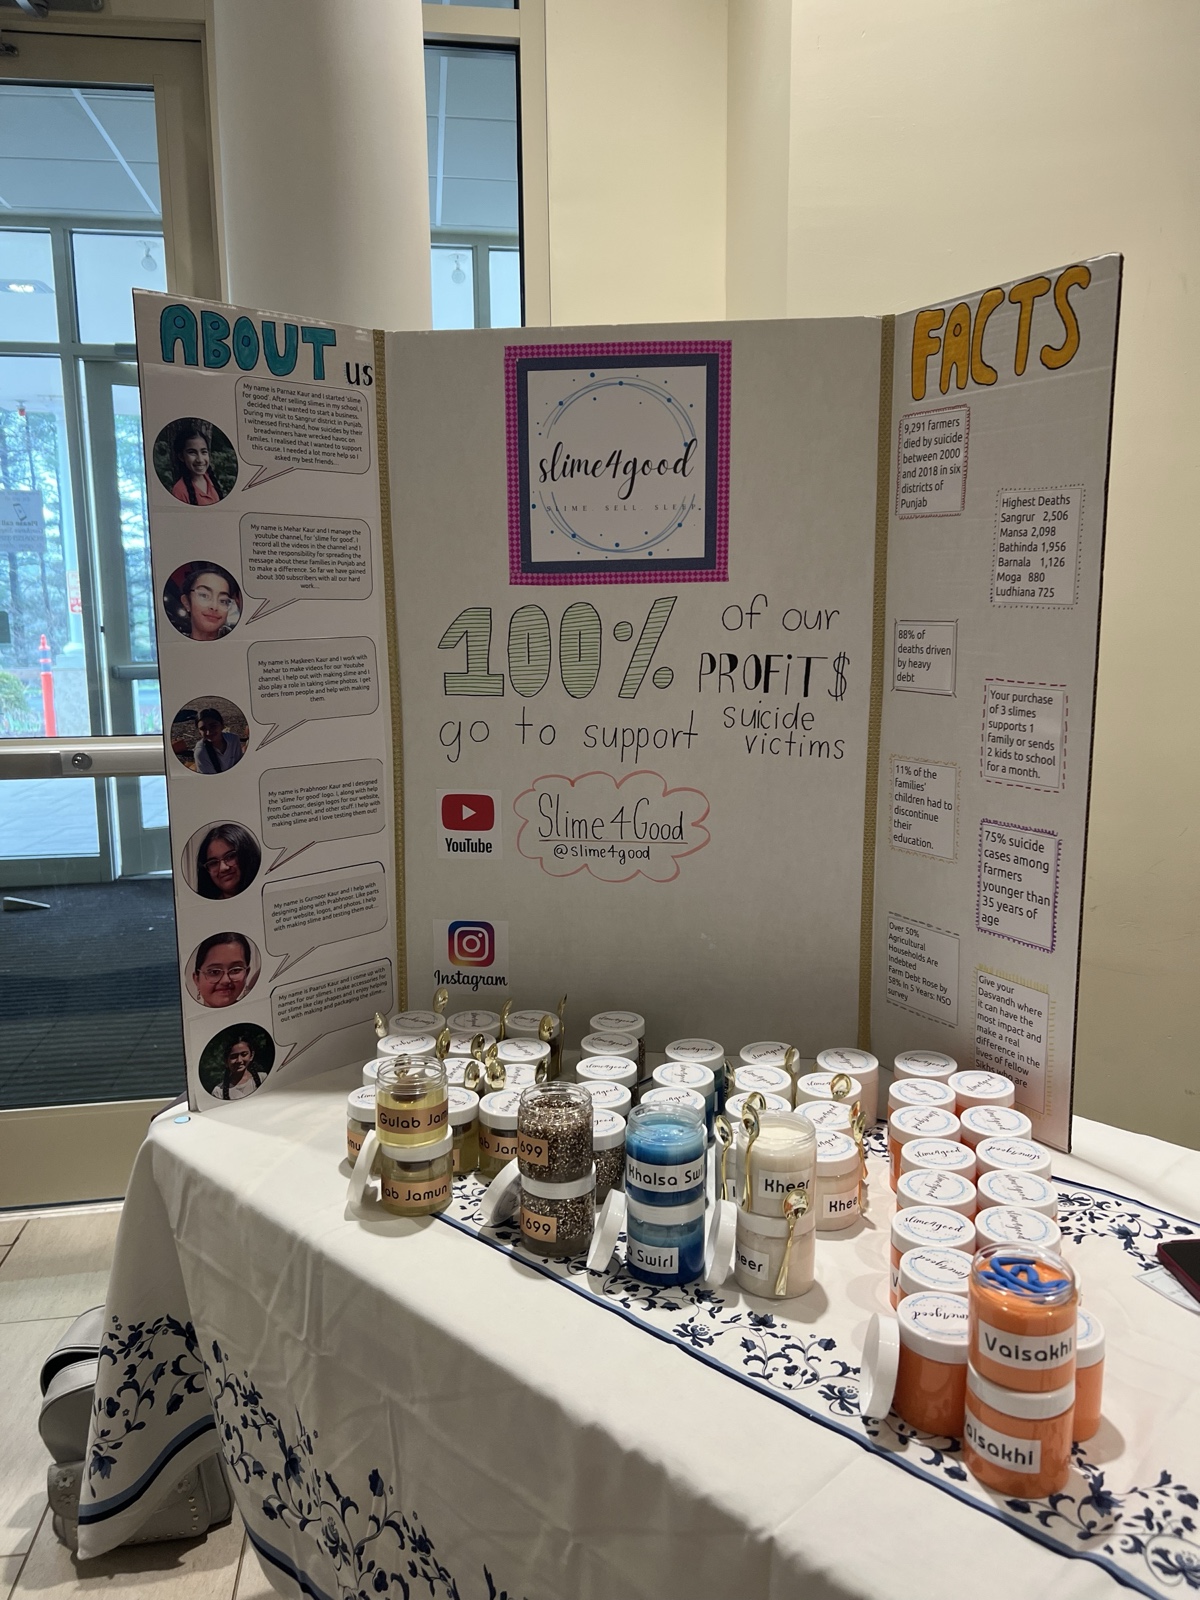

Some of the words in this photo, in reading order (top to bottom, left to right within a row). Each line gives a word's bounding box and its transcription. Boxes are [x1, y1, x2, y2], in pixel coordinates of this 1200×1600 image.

[912, 265, 1091, 401] FACTS
[160, 304, 337, 381] ABOUT
[254, 427, 293, 436] breadwinners
[904, 422, 925, 435] 9,291
[928, 419, 960, 430] farmers
[904, 437, 921, 448] died
[923, 436, 932, 448] by
[934, 432, 963, 445] suicide
[903, 453, 938, 464] between
[940, 448, 960, 460] 2000
[539, 438, 698, 500] slime4good
[902, 467, 916, 479] and
[918, 466, 938, 477] 2018
[940, 465, 947, 475] in
[950, 464, 960, 474] six
[902, 482, 933, 494] districts
[935, 480, 944, 491] of
[901, 497, 927, 510] Punjab
[1002, 497, 1036, 509] Highest
[1038, 494, 1070, 506] Deaths
[1001, 513, 1035, 524] Sangrur
[1043, 510, 1068, 522] 2,506
[1000, 528, 1028, 537] Mansa
[1031, 526, 1056, 538] 2,098
[999, 541, 1038, 552] Bathinda
[1042, 542, 1066, 553] 1,956
[998, 556, 1030, 567] Barnala
[1041, 557, 1065, 568] 1,126
[997, 572, 1021, 584] Moga
[1028, 572, 1045, 582] 880
[996, 586, 1035, 597] Ludhiana
[1038, 588, 1054, 598] 725
[721, 593, 769, 631] of
[782, 608, 840, 631] our
[898, 630, 915, 639] 88%
[917, 630, 926, 639] of
[437, 596, 678, 699] 100%
[898, 644, 924, 654] deaths
[926, 644, 951, 655] driven
[898, 658, 906, 669] by
[908, 658, 931, 671] heavy
[897, 672, 914, 682] debt
[990, 690, 1010, 700] Your
[1012, 693, 1053, 705] purchase
[723, 700, 815, 731] suicide
[990, 704, 999, 714] of
[1008, 706, 1036, 718] slimes
[439, 719, 490, 763] go
[515, 706, 556, 746] to
[583, 710, 699, 764] support
[988, 721, 1026, 732] supports
[745, 733, 845, 760] victims
[988, 733, 1014, 747] family
[1028, 740, 1054, 751] sends
[995, 748, 1012, 759] kids
[1014, 751, 1024, 761] to
[1026, 753, 1055, 766] school
[896, 765, 912, 775] 11%
[914, 767, 922, 776] of
[923, 769, 937, 779] the
[987, 761, 1000, 772] for
[1009, 767, 1040, 778] month.
[895, 778, 926, 791] families'
[895, 792, 925, 805] children
[927, 797, 942, 808] had
[944, 801, 952, 810] to
[894, 805, 938, 822] discontinue
[894, 819, 912, 830] their
[444, 837, 493, 854] YouTube
[893, 834, 933, 849] education.
[985, 830, 1006, 844] 75%
[1009, 837, 1044, 853] suicide
[553, 844, 651, 865] @slime4good
[984, 849, 1010, 862] cases
[1013, 856, 1049, 873] among
[984, 862, 1022, 882] farmers
[982, 881, 1024, 899] younger
[1027, 891, 1050, 906] than
[982, 895, 994, 907] 35
[996, 902, 1023, 916] years
[1026, 908, 1038, 919] of
[982, 914, 999, 926] age
[889, 922, 904, 932] Over
[905, 927, 919, 938] 50%
[888, 934, 925, 951] Agricultural
[433, 970, 508, 992] Instagram
[979, 975, 995, 988] Give
[996, 983, 1014, 994] your
[304, 1007, 322, 1015] making
[324, 1002, 333, 1010] and
[334, 997, 359, 1008] packaging
[978, 987, 1015, 1008] Dasvandh
[1017, 1003, 1042, 1018] where
[985, 1004, 998, 1014] can
[1000, 1007, 1018, 1021] have
[1020, 1015, 1033, 1027] the
[977, 1013, 996, 1025] most
[998, 1019, 1024, 1037] impact
[1026, 1032, 1041, 1043] and
[977, 1025, 996, 1038] make
[1005, 1036, 1020, 1047] real
[380, 1112, 420, 1128] Gulab
[518, 1137, 542, 1158] 699
[629, 1164, 677, 1186] Khalsa
[685, 1165, 702, 1183] Swi
[405, 1185, 447, 1201] Jamun
[765, 1179, 809, 1192] Kheer
[829, 1197, 857, 1212] Khee
[905, 1216, 963, 1232] slime4good
[637, 1250, 673, 1267] Swirl
[985, 1332, 1072, 1361] Vaisakhi
[966, 1423, 1033, 1465] aisakhi
